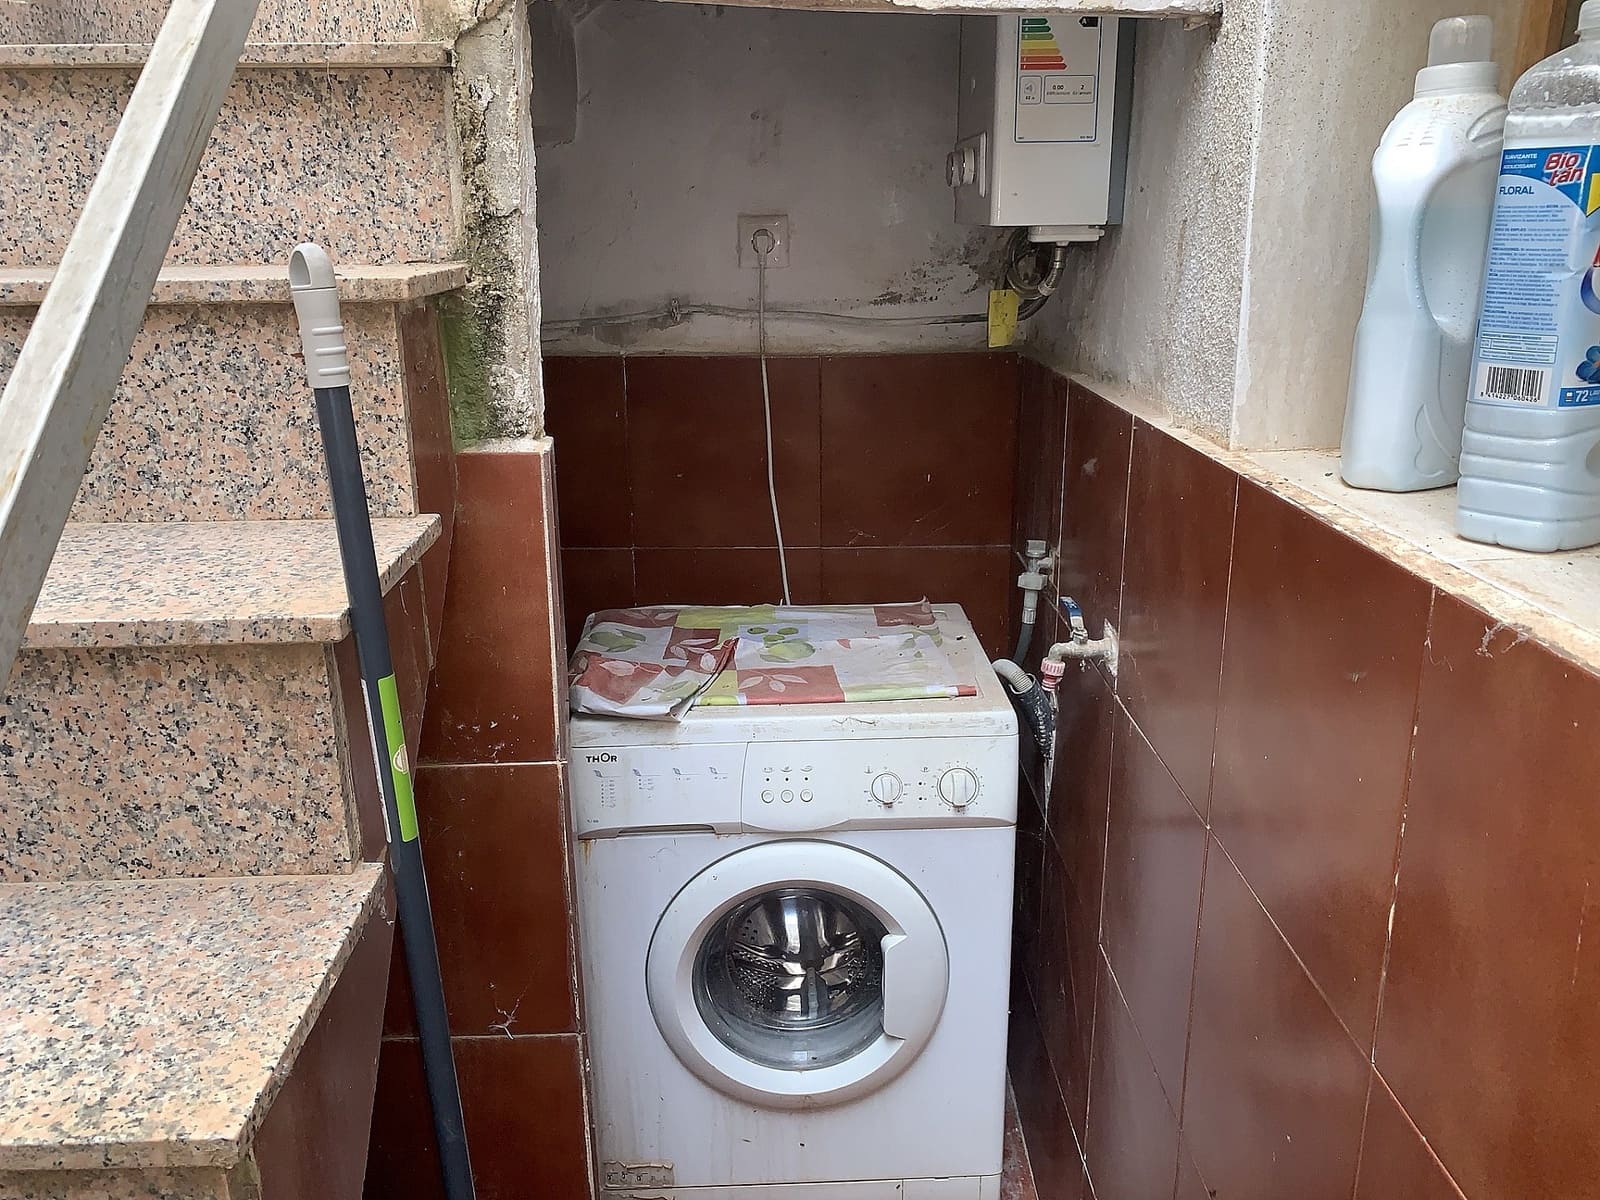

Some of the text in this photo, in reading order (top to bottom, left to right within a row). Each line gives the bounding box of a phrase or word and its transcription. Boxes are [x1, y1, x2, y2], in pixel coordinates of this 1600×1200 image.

[1499, 186, 1535, 195] FLORAL
[1575, 390, 1589, 402] 72
[586, 752, 618, 763] THOR
